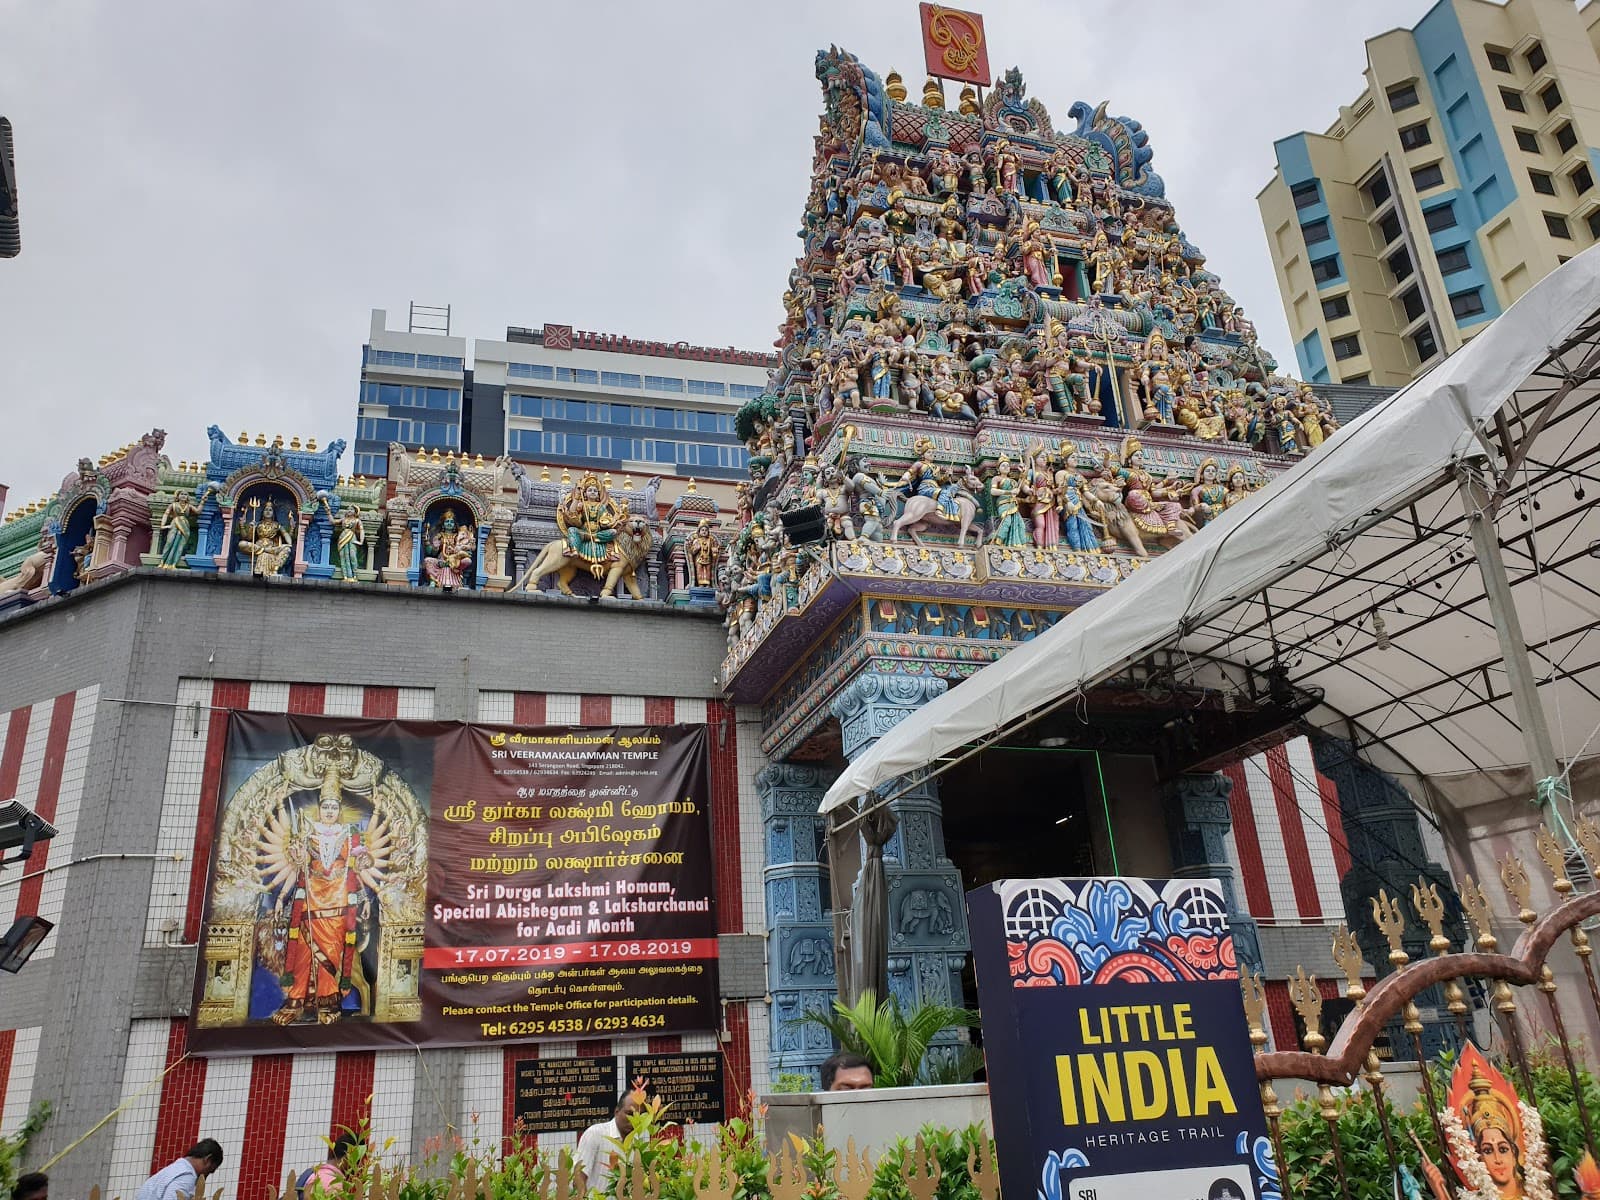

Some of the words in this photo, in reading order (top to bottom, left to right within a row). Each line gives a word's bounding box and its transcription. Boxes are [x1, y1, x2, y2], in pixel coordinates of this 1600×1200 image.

[576, 330, 667, 357] Hilton
[673, 341, 768, 367] Garden
[490, 732, 506, 746] ஸ்ரீ
[509, 732, 615, 745] வீரமாகாளியம்மன்
[617, 734, 661, 748] ஆலயம்
[491, 750, 507, 759] SRI
[509, 750, 620, 760] VEERAMAKALIAMMAN
[622, 751, 659, 760] TEMPLE
[516, 787, 535, 798] ஆடி
[539, 785, 586, 798] மாதத்தை
[589, 785, 639, 798] முன்னிட்டு
[443, 800, 477, 822] ஸ்ரீ
[481, 801, 543, 823] துர்கா
[549, 800, 614, 823] லக்ஷ்மி
[621, 797, 701, 819] ஹோமம்,
[489, 826, 553, 848] சிறப்பு
[559, 823, 661, 847] அபிஷேகம்
[470, 853, 538, 875] மற்றும்
[545, 850, 684, 874] லக்ஷார்ச்சனை
[467, 884, 489, 900] Sri
[495, 885, 542, 901] Durga
[547, 882, 610, 898] Lakshmi
[616, 880, 676, 896] Homam,
[433, 903, 490, 923] Special
[495, 902, 583, 920] Abishegam
[588, 901, 600, 915] &
[604, 896, 709, 914] Laksharchanai
[516, 921, 540, 937] for
[545, 920, 581, 937] Aadi
[587, 917, 635, 934] Month
[455, 947, 566, 963] 17.07.2019
[590, 942, 692, 957] 17.08.2019
[441, 973, 489, 984] பங்குபெற
[491, 970, 532, 982] விரும்பும்
[557, 967, 606, 978] அன்பர்கள்
[608, 967, 636, 978] ஆலய
[638, 963, 703, 976] அலுவலகத்தை
[527, 985, 566, 997] தொடர்பு
[569, 982, 625, 993] கொள்ளவும்.
[442, 1006, 474, 1016] Please
[475, 1004, 511, 1014] contact
[512, 1003, 529, 1013] the
[529, 1001, 564, 1012] Temple
[565, 999, 592, 1010] Office
[593, 1000, 607, 1008] for
[608, 997, 666, 1010] participation
[667, 995, 699, 1005] details.
[480, 1022, 506, 1036] Tel:
[509, 1020, 545, 1034] 6295
[547, 1019, 583, 1032] 4538
[585, 1017, 592, 1031] /
[594, 1016, 628, 1030] 6293
[631, 1014, 665, 1028] 4634
[1078, 1003, 1196, 1045] LITTLE
[538, 1061, 546, 1069] THE
[543, 1076, 559, 1084] TEMPLE
[559, 1075, 577, 1083] PROJECT
[1055, 1046, 1238, 1126] INDIA
[1085, 1130, 1171, 1148] HERITAGE
[1178, 1125, 1225, 1141] TRAIL
